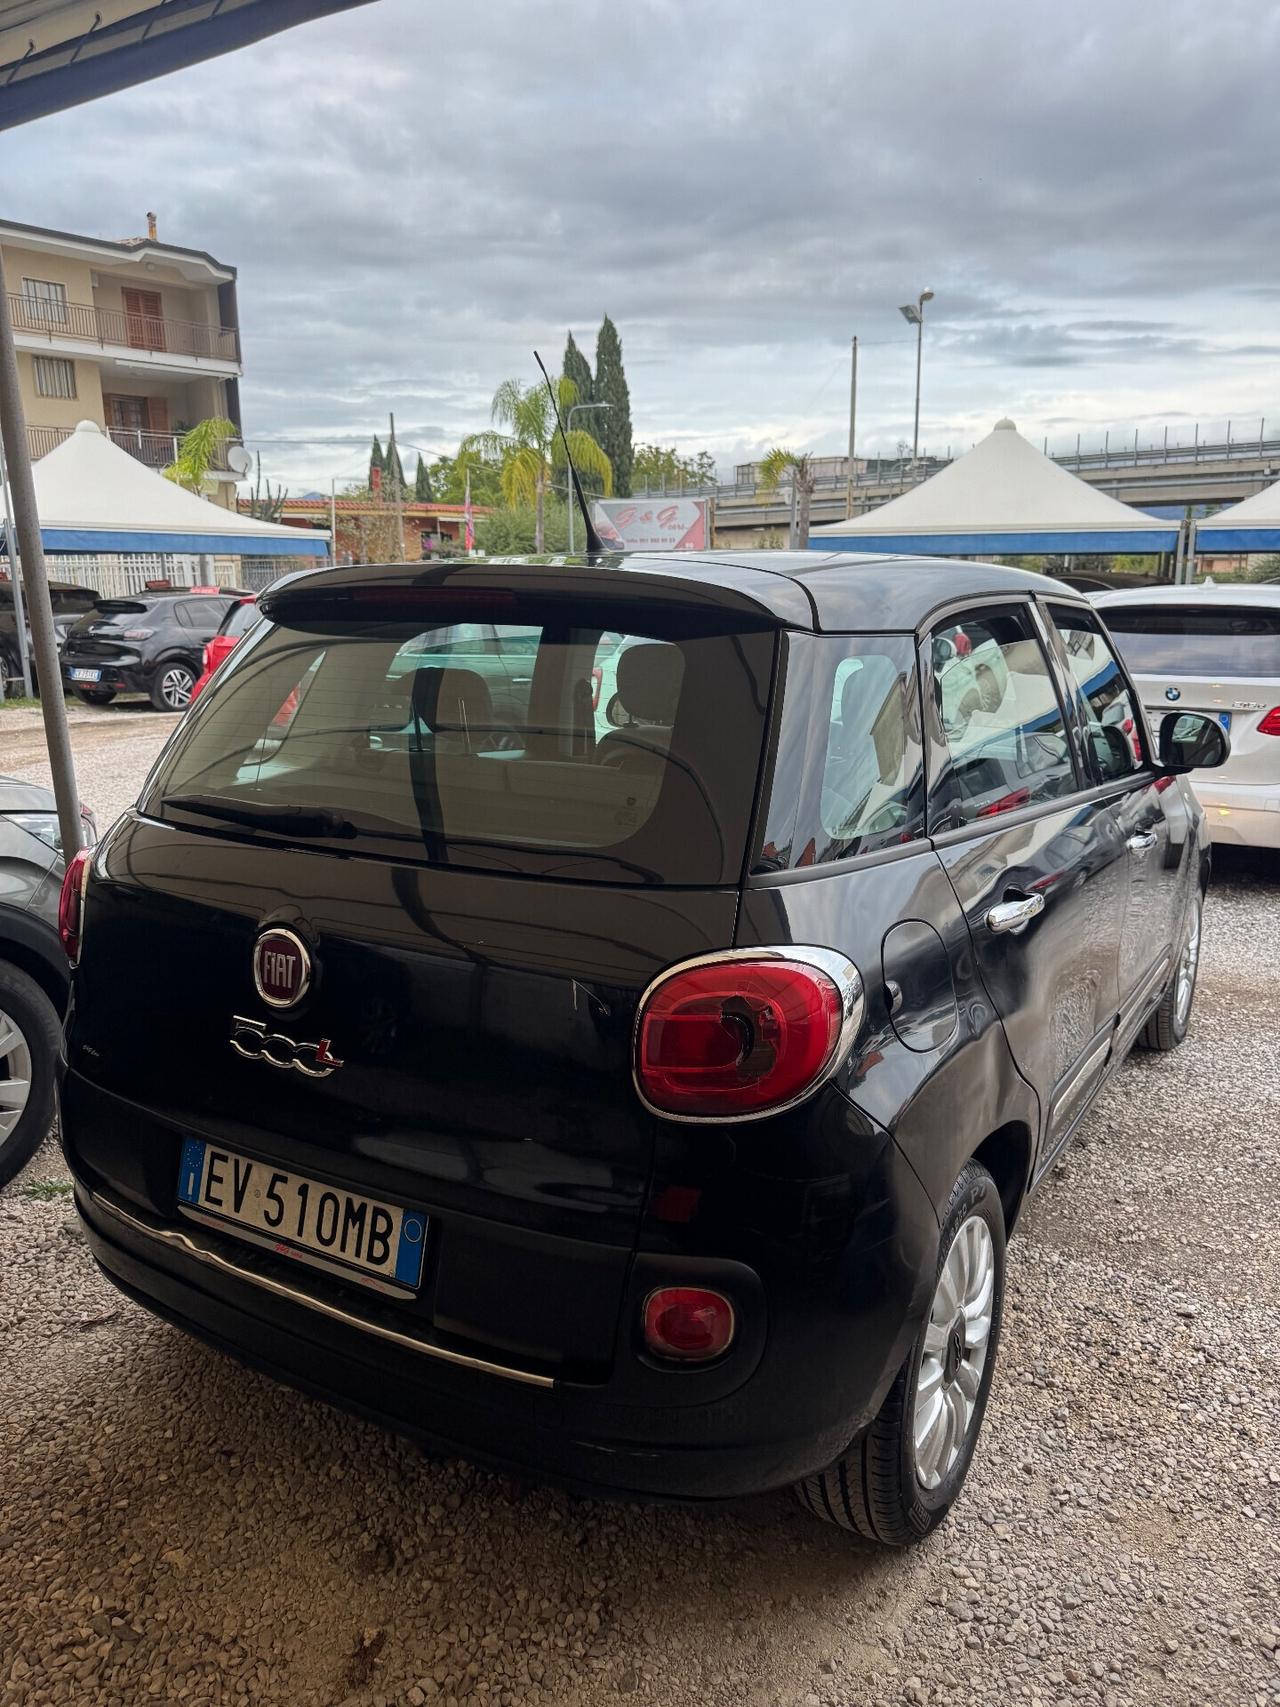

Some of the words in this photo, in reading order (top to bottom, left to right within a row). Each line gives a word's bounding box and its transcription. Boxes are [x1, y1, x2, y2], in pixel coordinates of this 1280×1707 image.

[263, 950, 296, 989] FIAT
[229, 1014, 345, 1078] 500L
[204, 1151, 252, 1213] EV
[263, 1172, 394, 1266] 510MB
